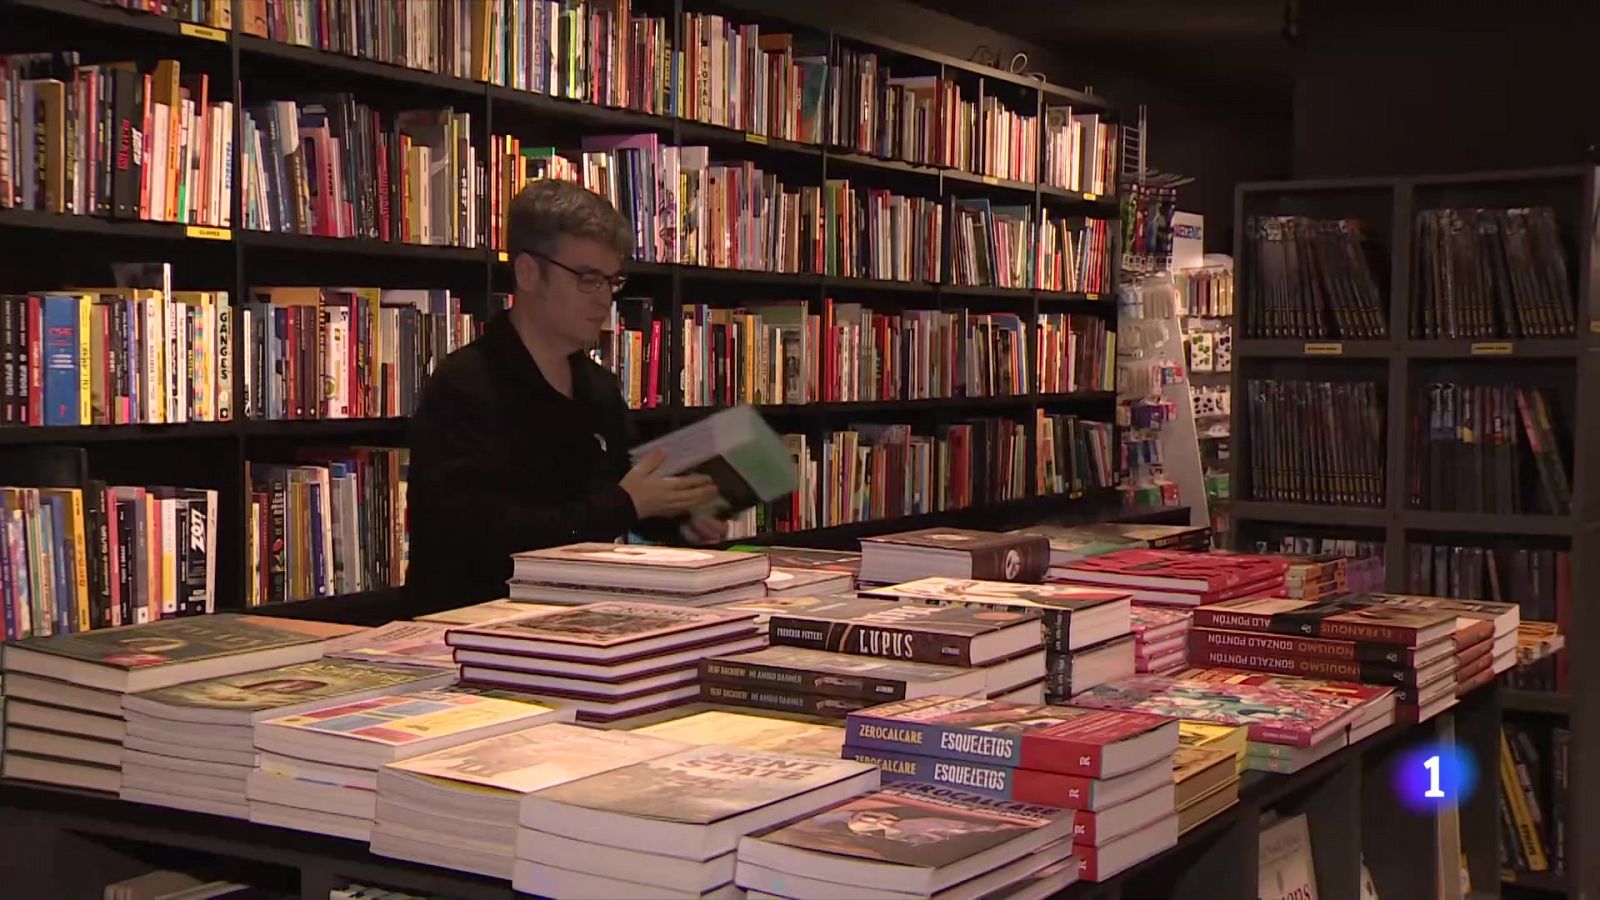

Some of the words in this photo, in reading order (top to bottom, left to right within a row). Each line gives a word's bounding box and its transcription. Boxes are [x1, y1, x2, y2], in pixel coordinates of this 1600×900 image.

[701, 61, 709, 106] TOTAL
[219, 311, 228, 380] GANGES
[1212, 614, 1250, 626] PONTÓN
[1320, 622, 1378, 638] FRANQUIS
[858, 629, 913, 658] LUPUS
[1208, 634, 1246, 646] PONTÓN
[1249, 637, 1293, 650] GONZALO
[1209, 652, 1248, 665] PONTÓN
[1249, 655, 1295, 669] GONZALO
[1300, 661, 1361, 675] NQUISMO
[859, 724, 923, 744] ZEROCALCARE
[940, 732, 1014, 759] ESQUELETOS
[677, 759, 815, 780] STATE
[934, 763, 1006, 791] ESQUELETOS
[890, 780, 1061, 815] ZEROCALCARE
